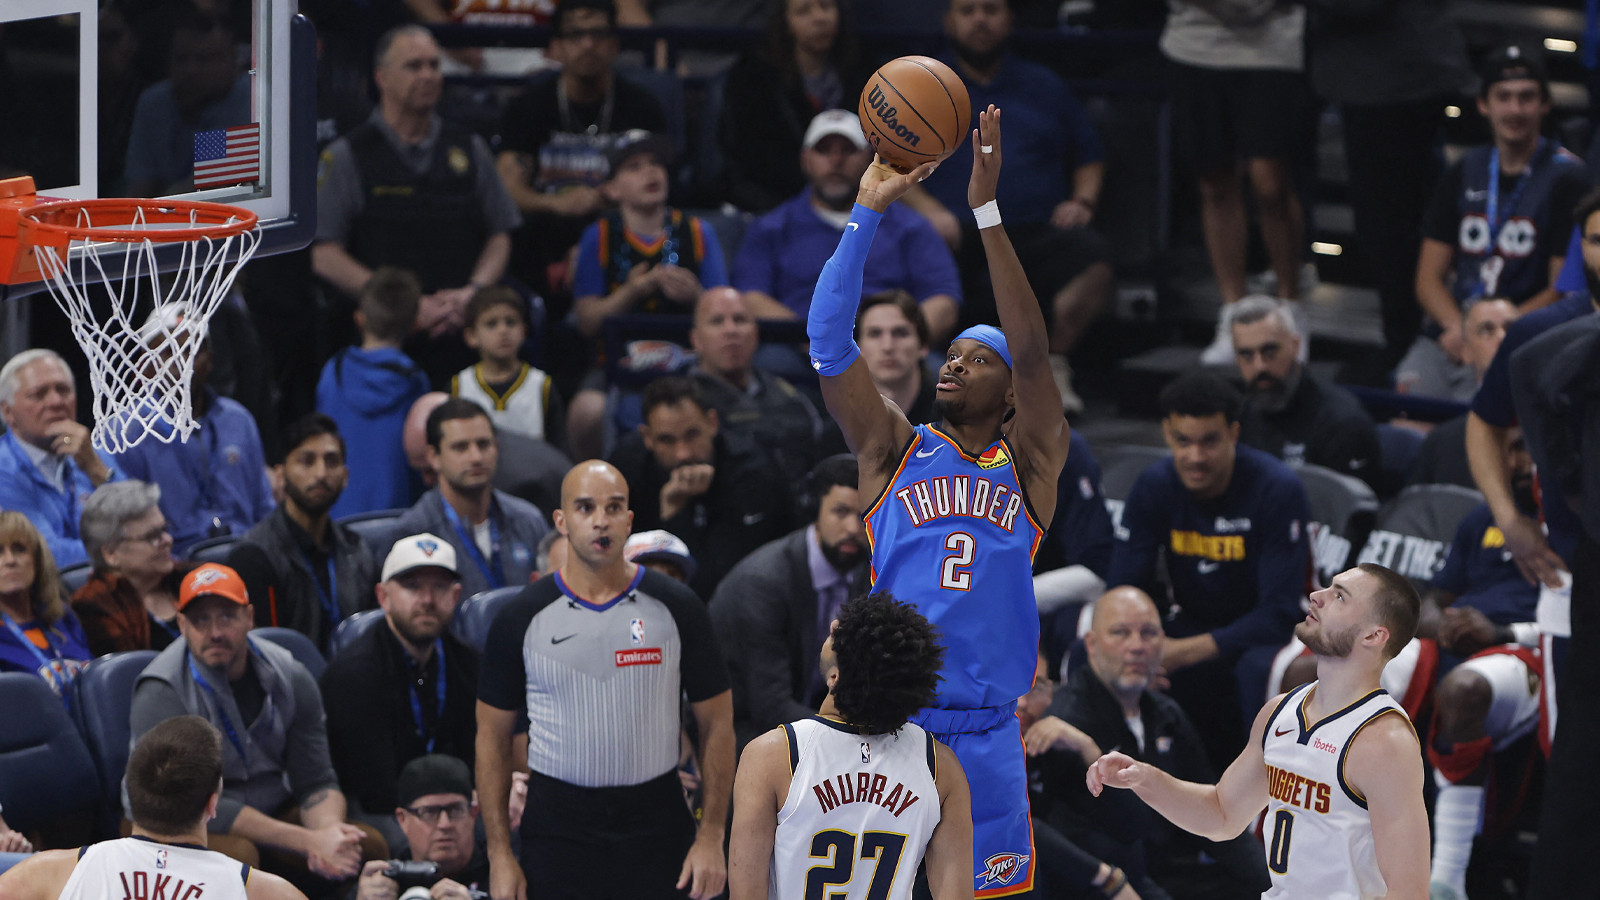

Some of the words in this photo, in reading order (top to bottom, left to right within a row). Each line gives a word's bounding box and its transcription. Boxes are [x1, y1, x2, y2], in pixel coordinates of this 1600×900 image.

[868, 83, 920, 147] Wilson
[895, 475, 1022, 534] THUNDER
[940, 531, 977, 591] 2
[616, 651, 661, 665] Emirates
[1314, 737, 1337, 754] ibotta
[813, 772, 919, 818] MURRAY
[804, 828, 909, 900] 27
[988, 857, 1014, 881] OKC
[1269, 809, 1295, 875] 0
